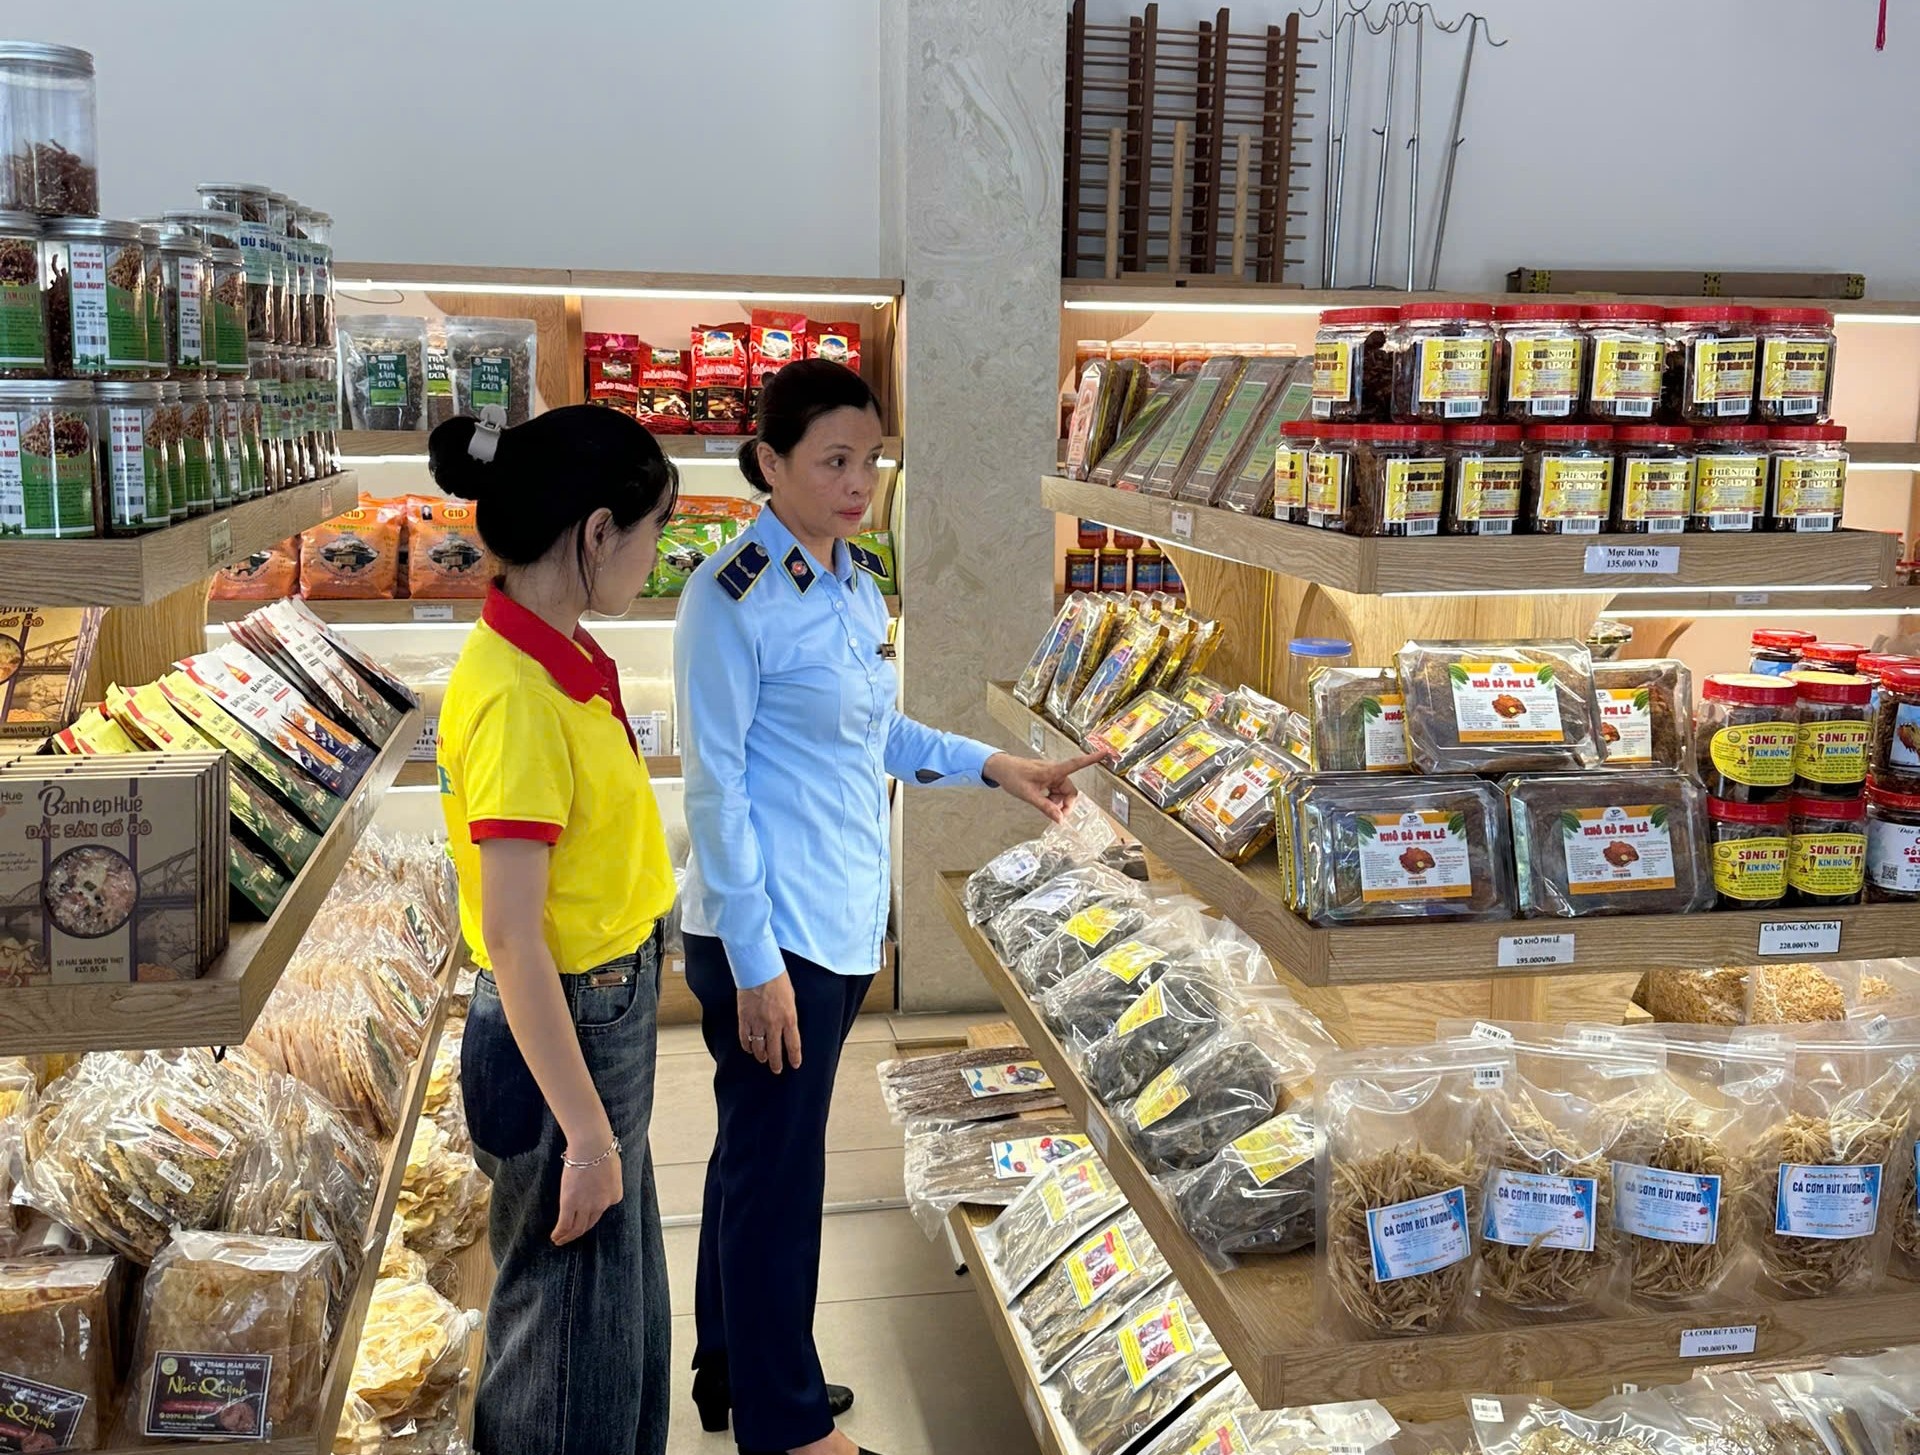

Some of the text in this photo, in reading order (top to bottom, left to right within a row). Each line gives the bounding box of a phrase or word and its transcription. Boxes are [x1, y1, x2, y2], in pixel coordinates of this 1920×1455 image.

[481, 373, 499, 381] SÂM
[448, 509, 464, 518] G10
[1607, 548, 1660, 558] Mực Rim Me
[1606, 560, 1637, 568] 135.000
[1472, 678, 1535, 688] KHÔ BÒ PHI LÊ
[1604, 704, 1631, 715] PHI LÊ
[1748, 734, 1777, 745] SÔNG
[1817, 733, 1847, 742] SÔNG
[1755, 749, 1769, 757] KIM
[1825, 746, 1839, 754] KIM
[114, 796, 143, 813] Huế
[102, 818, 124, 836] CỐ
[127, 819, 152, 836] ĐÔ
[1583, 821, 1649, 836] KHÔ BÒ PHI LÊ
[1380, 828, 1446, 842] KHÔ BÒ PHI LÊ
[1746, 863, 1760, 871] KIM
[1818, 858, 1831, 867] KIM
[1553, 935, 1560, 943] LÊ
[1792, 1181, 1866, 1194] CÁ CƠM RÚT XƯƠNG
[1498, 1186, 1576, 1206] CÁ CƠM RÚT XƯƠNG
[1639, 1184, 1656, 1196] CƠM
[1658, 1186, 1673, 1198] RÚT
[1675, 1190, 1702, 1202] XƯƠNG
[1384, 1211, 1453, 1237] CÁ CƠM RÚT XƯƠNG
